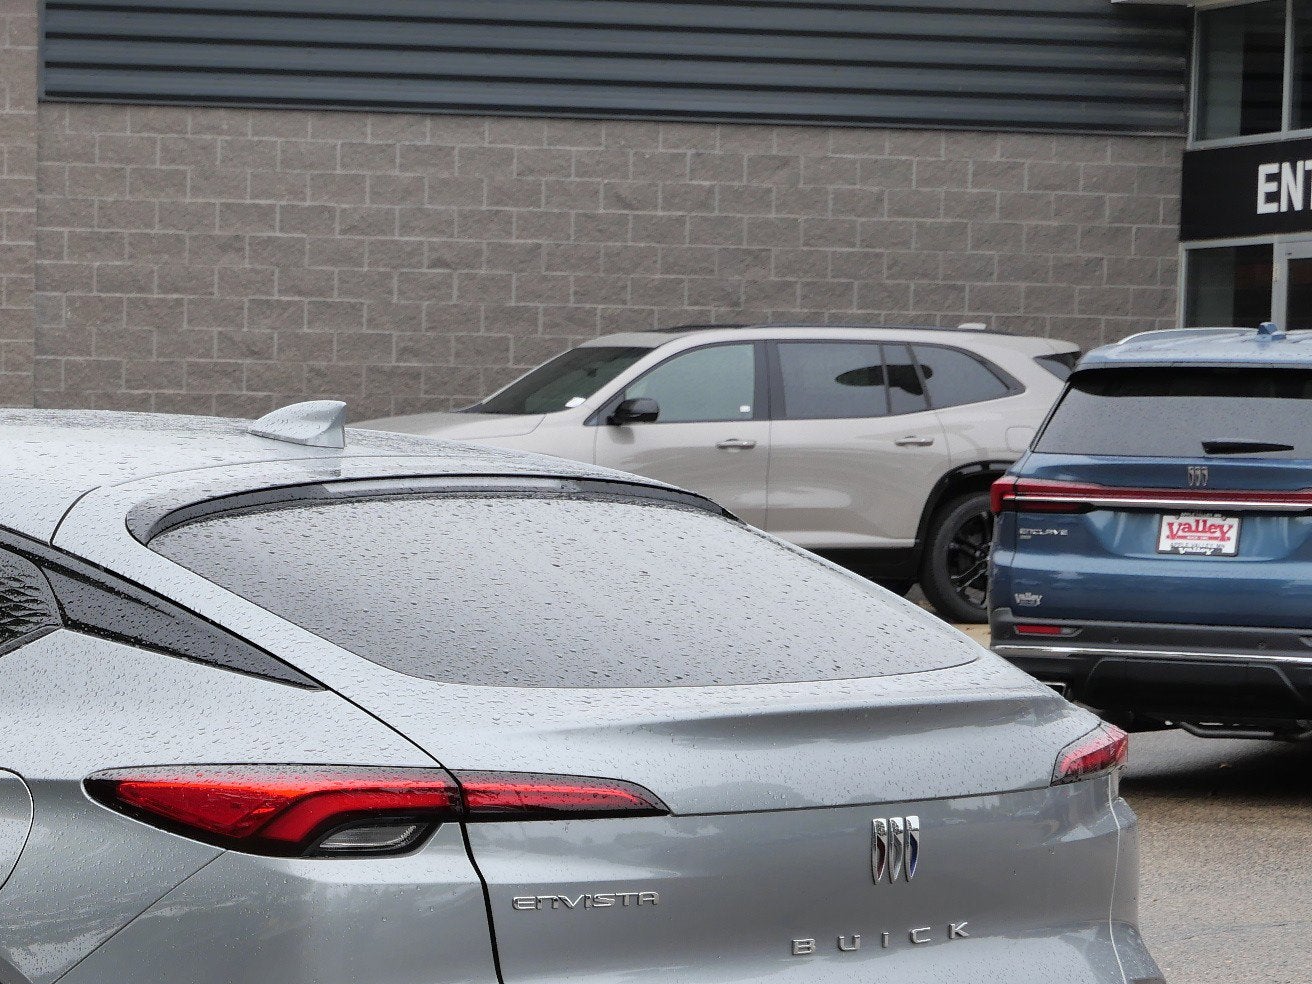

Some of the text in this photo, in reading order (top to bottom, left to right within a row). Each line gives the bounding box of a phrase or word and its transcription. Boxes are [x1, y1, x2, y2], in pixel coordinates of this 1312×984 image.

[1167, 519, 1233, 541] Valley
[512, 891, 660, 910] ENVISTA
[792, 921, 970, 955] BUICK
